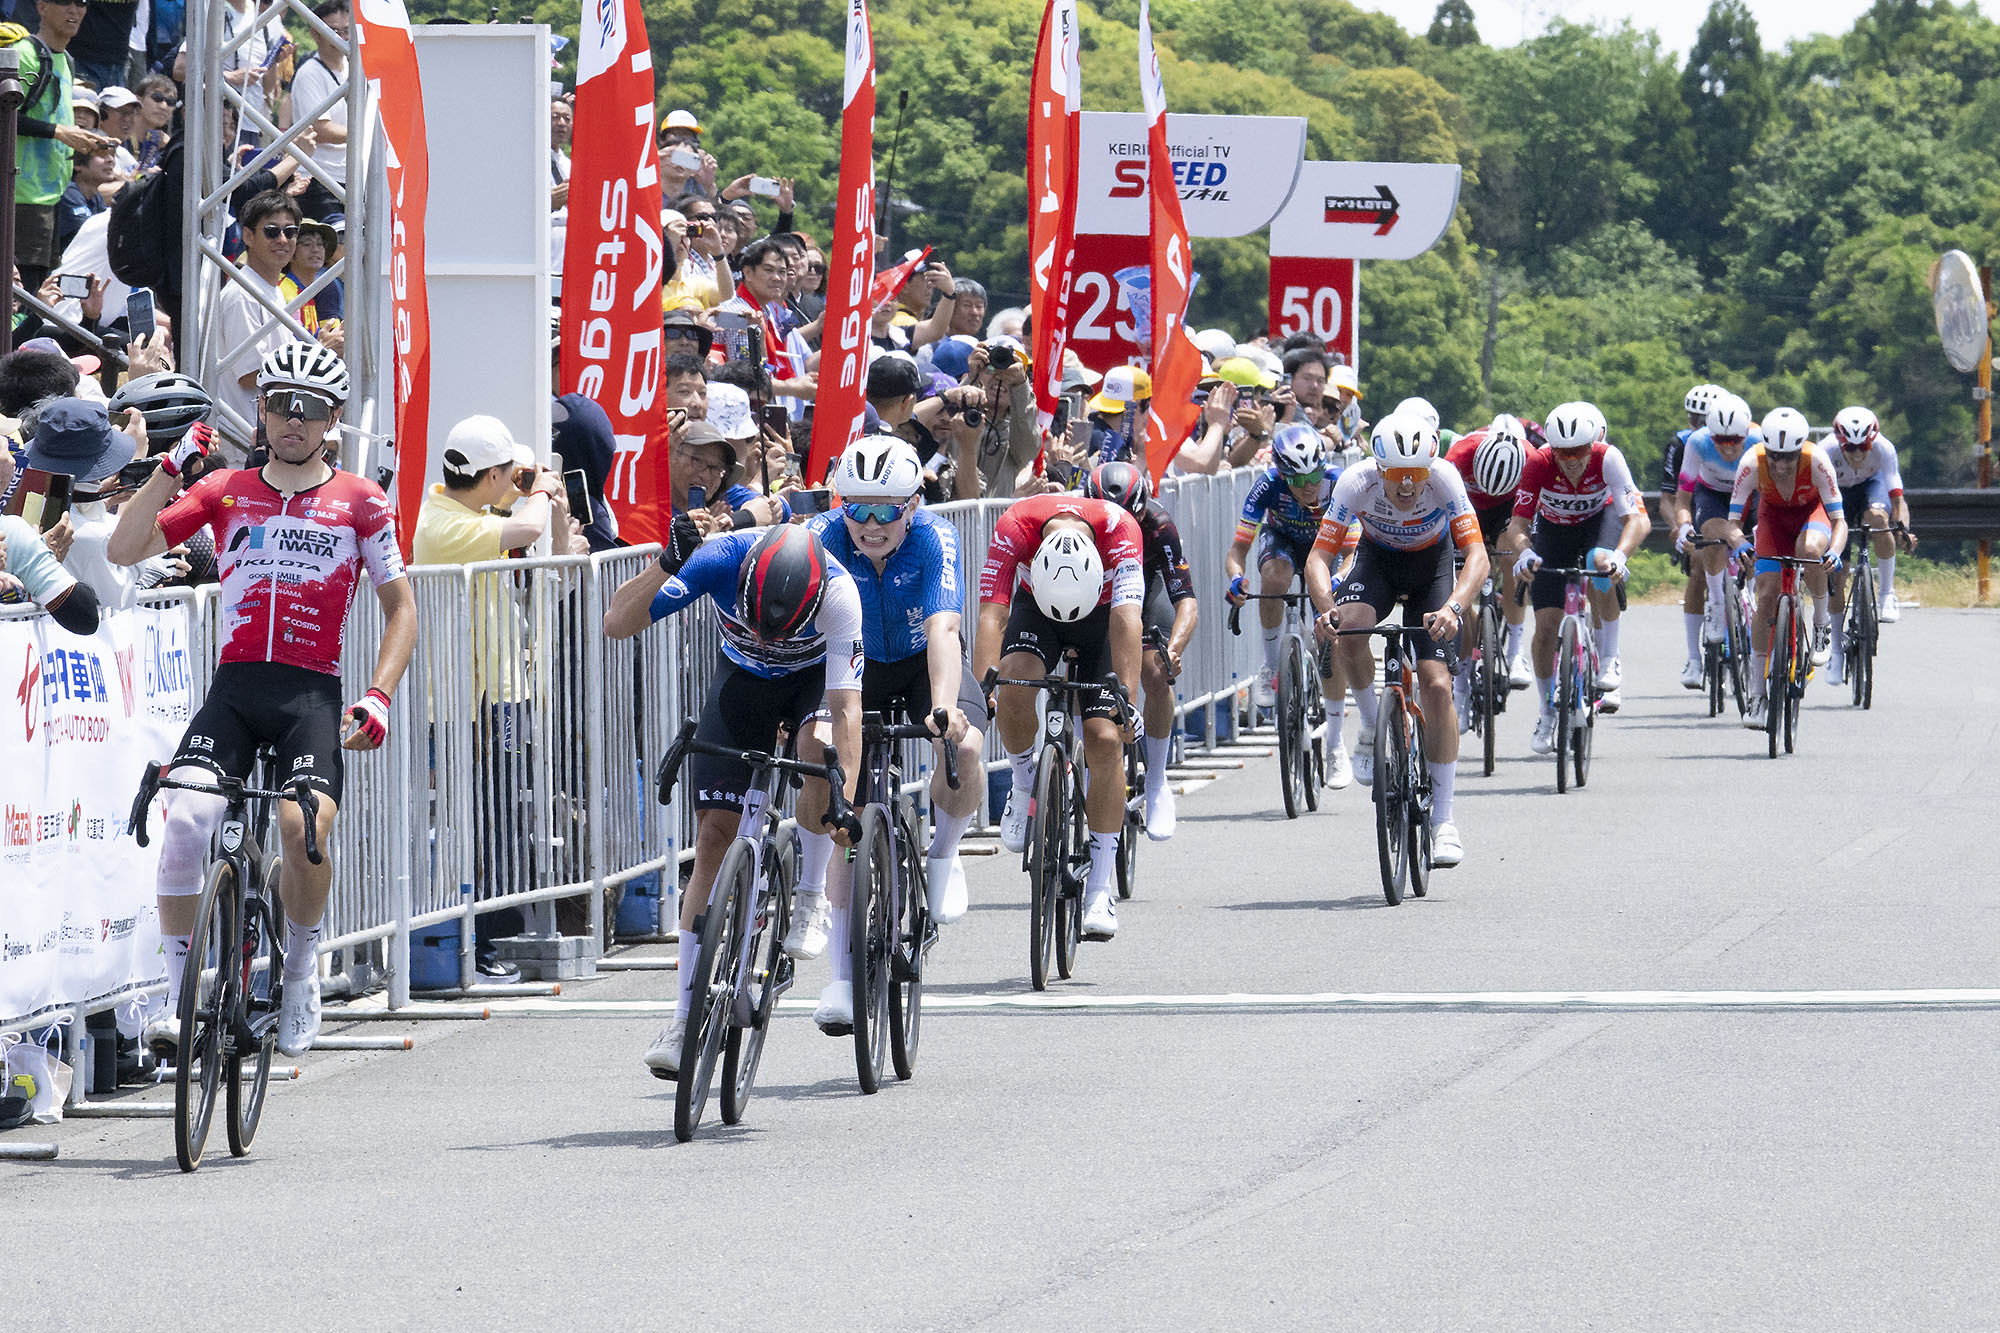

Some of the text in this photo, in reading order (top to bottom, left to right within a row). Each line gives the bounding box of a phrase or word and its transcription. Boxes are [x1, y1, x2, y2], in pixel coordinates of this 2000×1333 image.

[1215, 146, 1230, 158] TV
[1108, 160, 1227, 198] SEED
[576, 177, 628, 399] Stage
[840, 182, 871, 389] Stage
[1072, 271, 1138, 342] 25
[1280, 285, 1342, 343] 50
[1249, 481, 1269, 505] NIPPO
[316, 510, 338, 520] MJS
[272, 528, 342, 547] ANEST
[279, 540, 334, 558] IWATA
[244, 559, 321, 573] KUOTA
[290, 619, 321, 632] COSMO
[88, 715, 110, 743] BODY
[190, 735, 215, 749] B3
[293, 754, 315, 769] B3
[4, 803, 32, 846] Mazak
